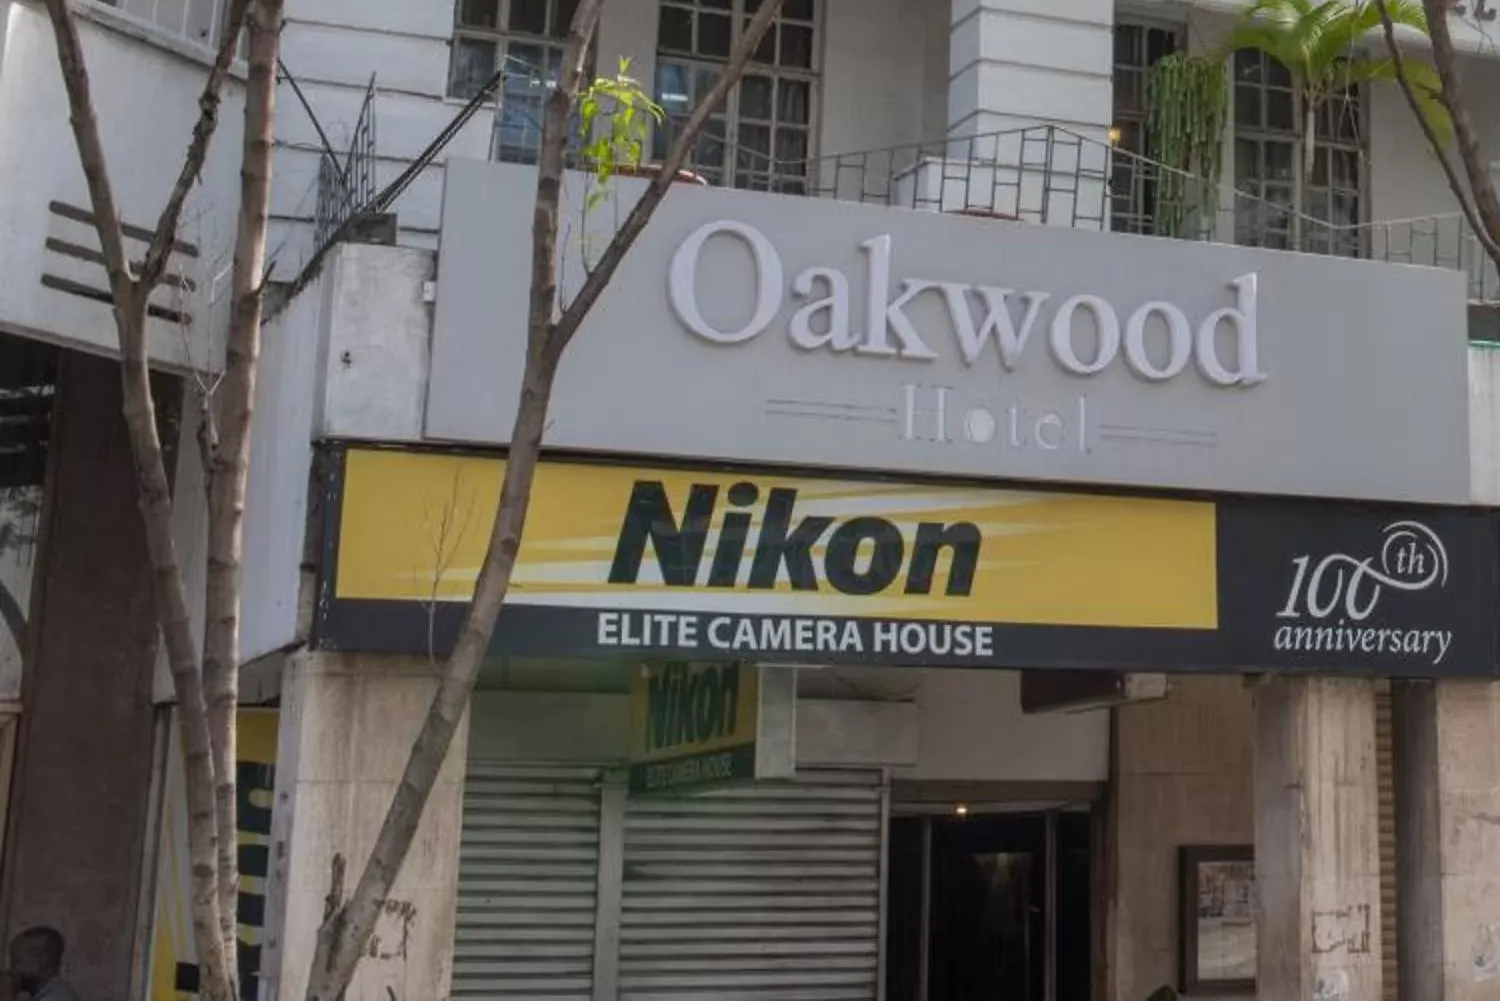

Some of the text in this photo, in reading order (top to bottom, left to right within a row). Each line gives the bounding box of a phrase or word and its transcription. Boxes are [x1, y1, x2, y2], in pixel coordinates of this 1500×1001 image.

[667, 219, 1268, 389] Oakwood
[900, 383, 1091, 455] Hotel
[608, 479, 982, 597] Nikon
[599, 612, 994, 657] ELITE CAMERA HOUSE
[1273, 620, 1452, 665] anniversary
